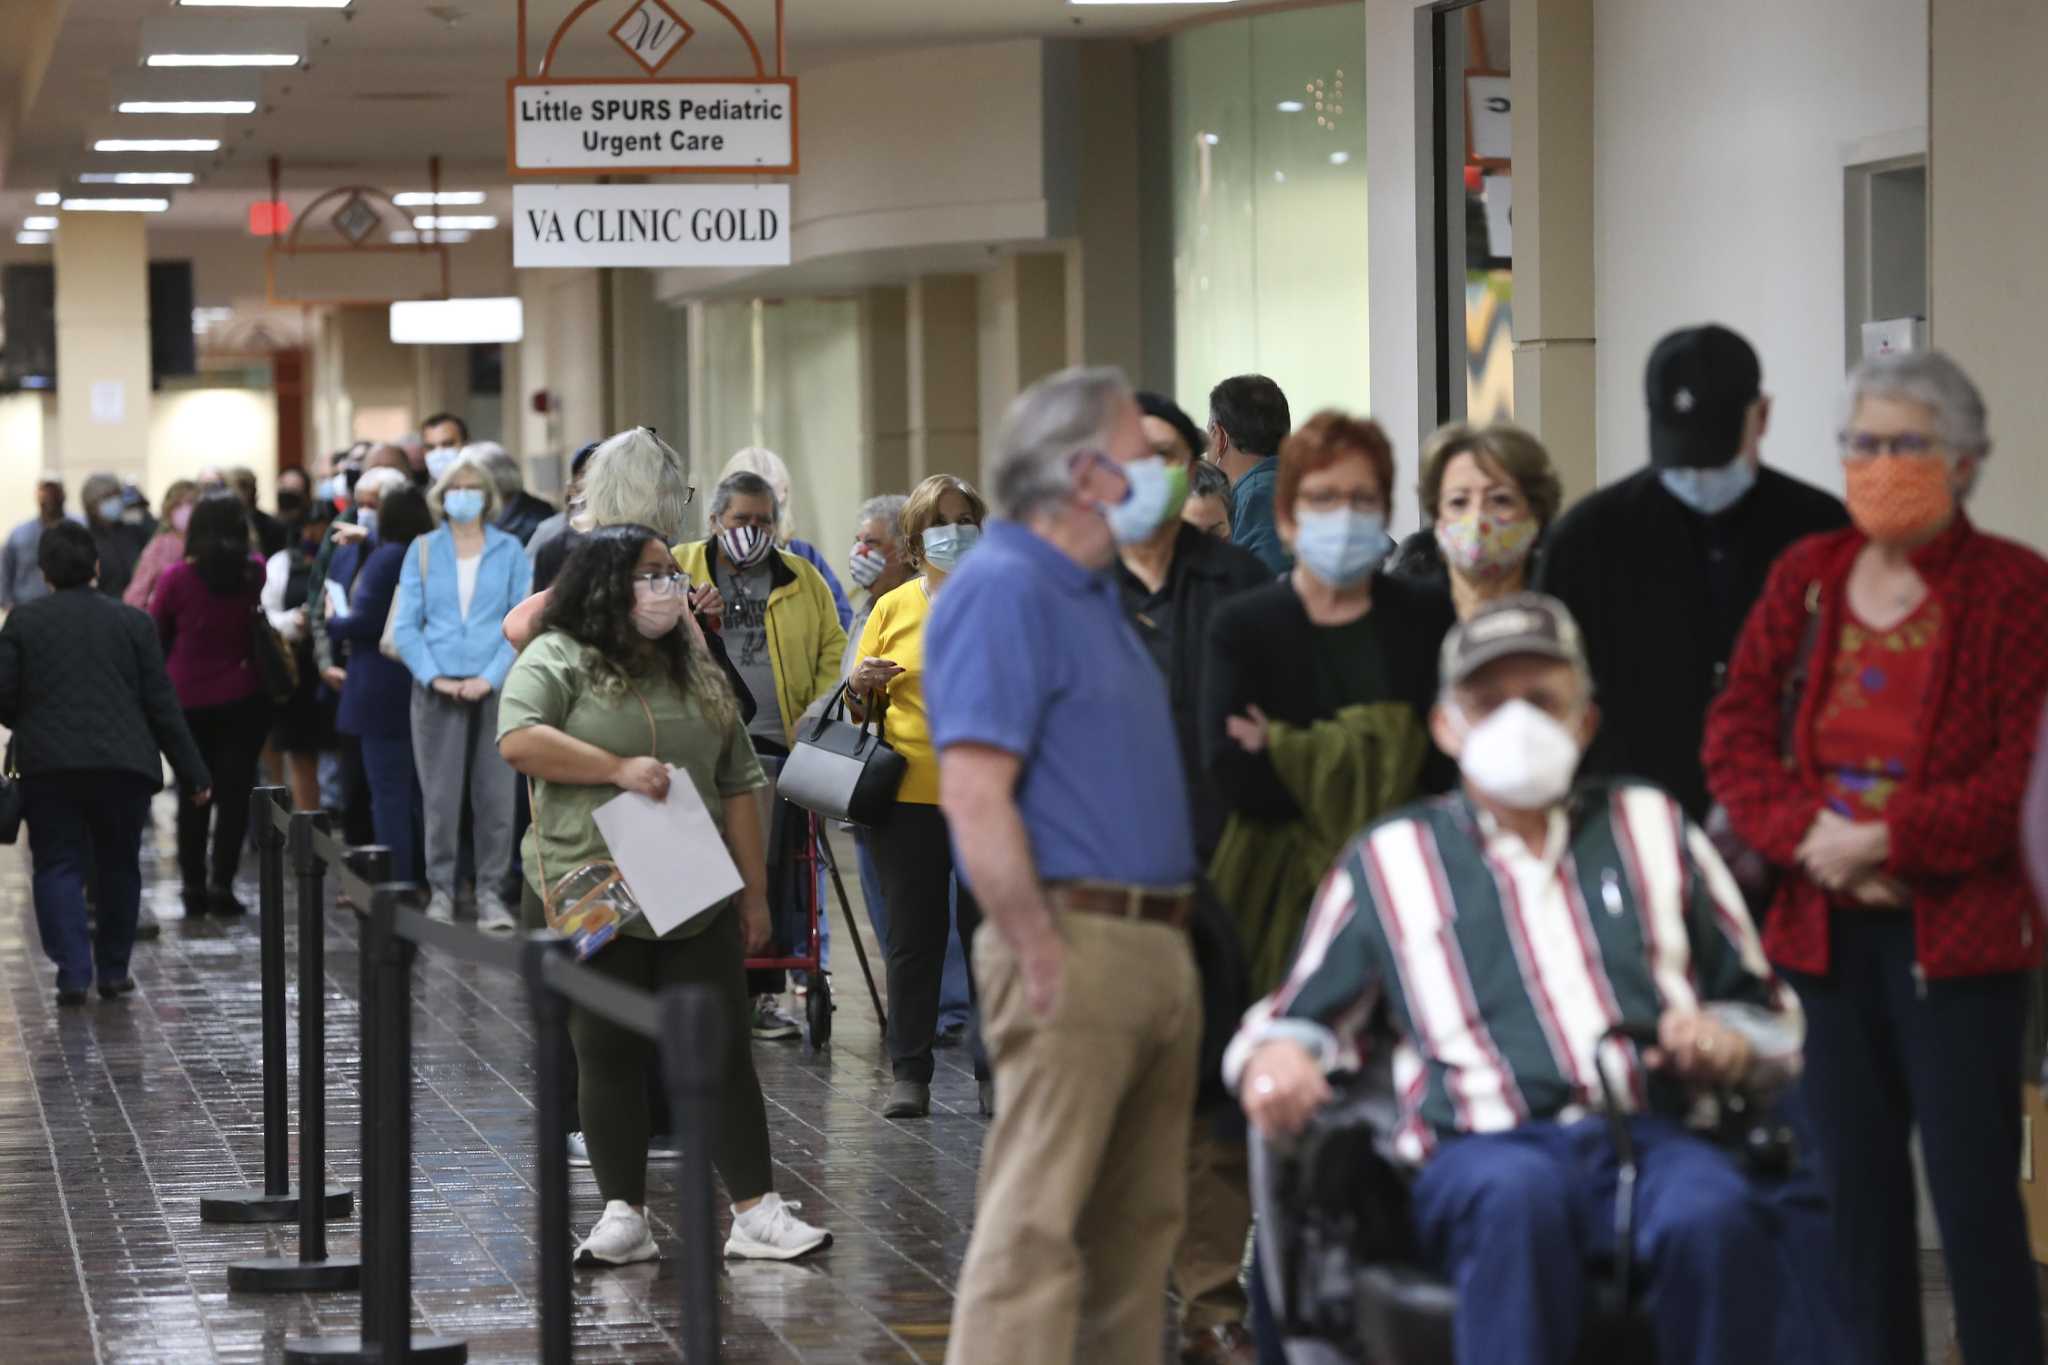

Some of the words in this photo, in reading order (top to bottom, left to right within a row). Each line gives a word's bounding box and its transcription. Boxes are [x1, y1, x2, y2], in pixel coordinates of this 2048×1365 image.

[521, 100, 583, 122] Little
[591, 99, 672, 121] SPURS
[679, 98, 783, 121] Pediatric
[583, 130, 662, 157] Urgent
[670, 130, 724, 151] Care
[528, 210, 565, 242] VA
[575, 209, 681, 242] CLINIC
[691, 209, 778, 242] GOLD
